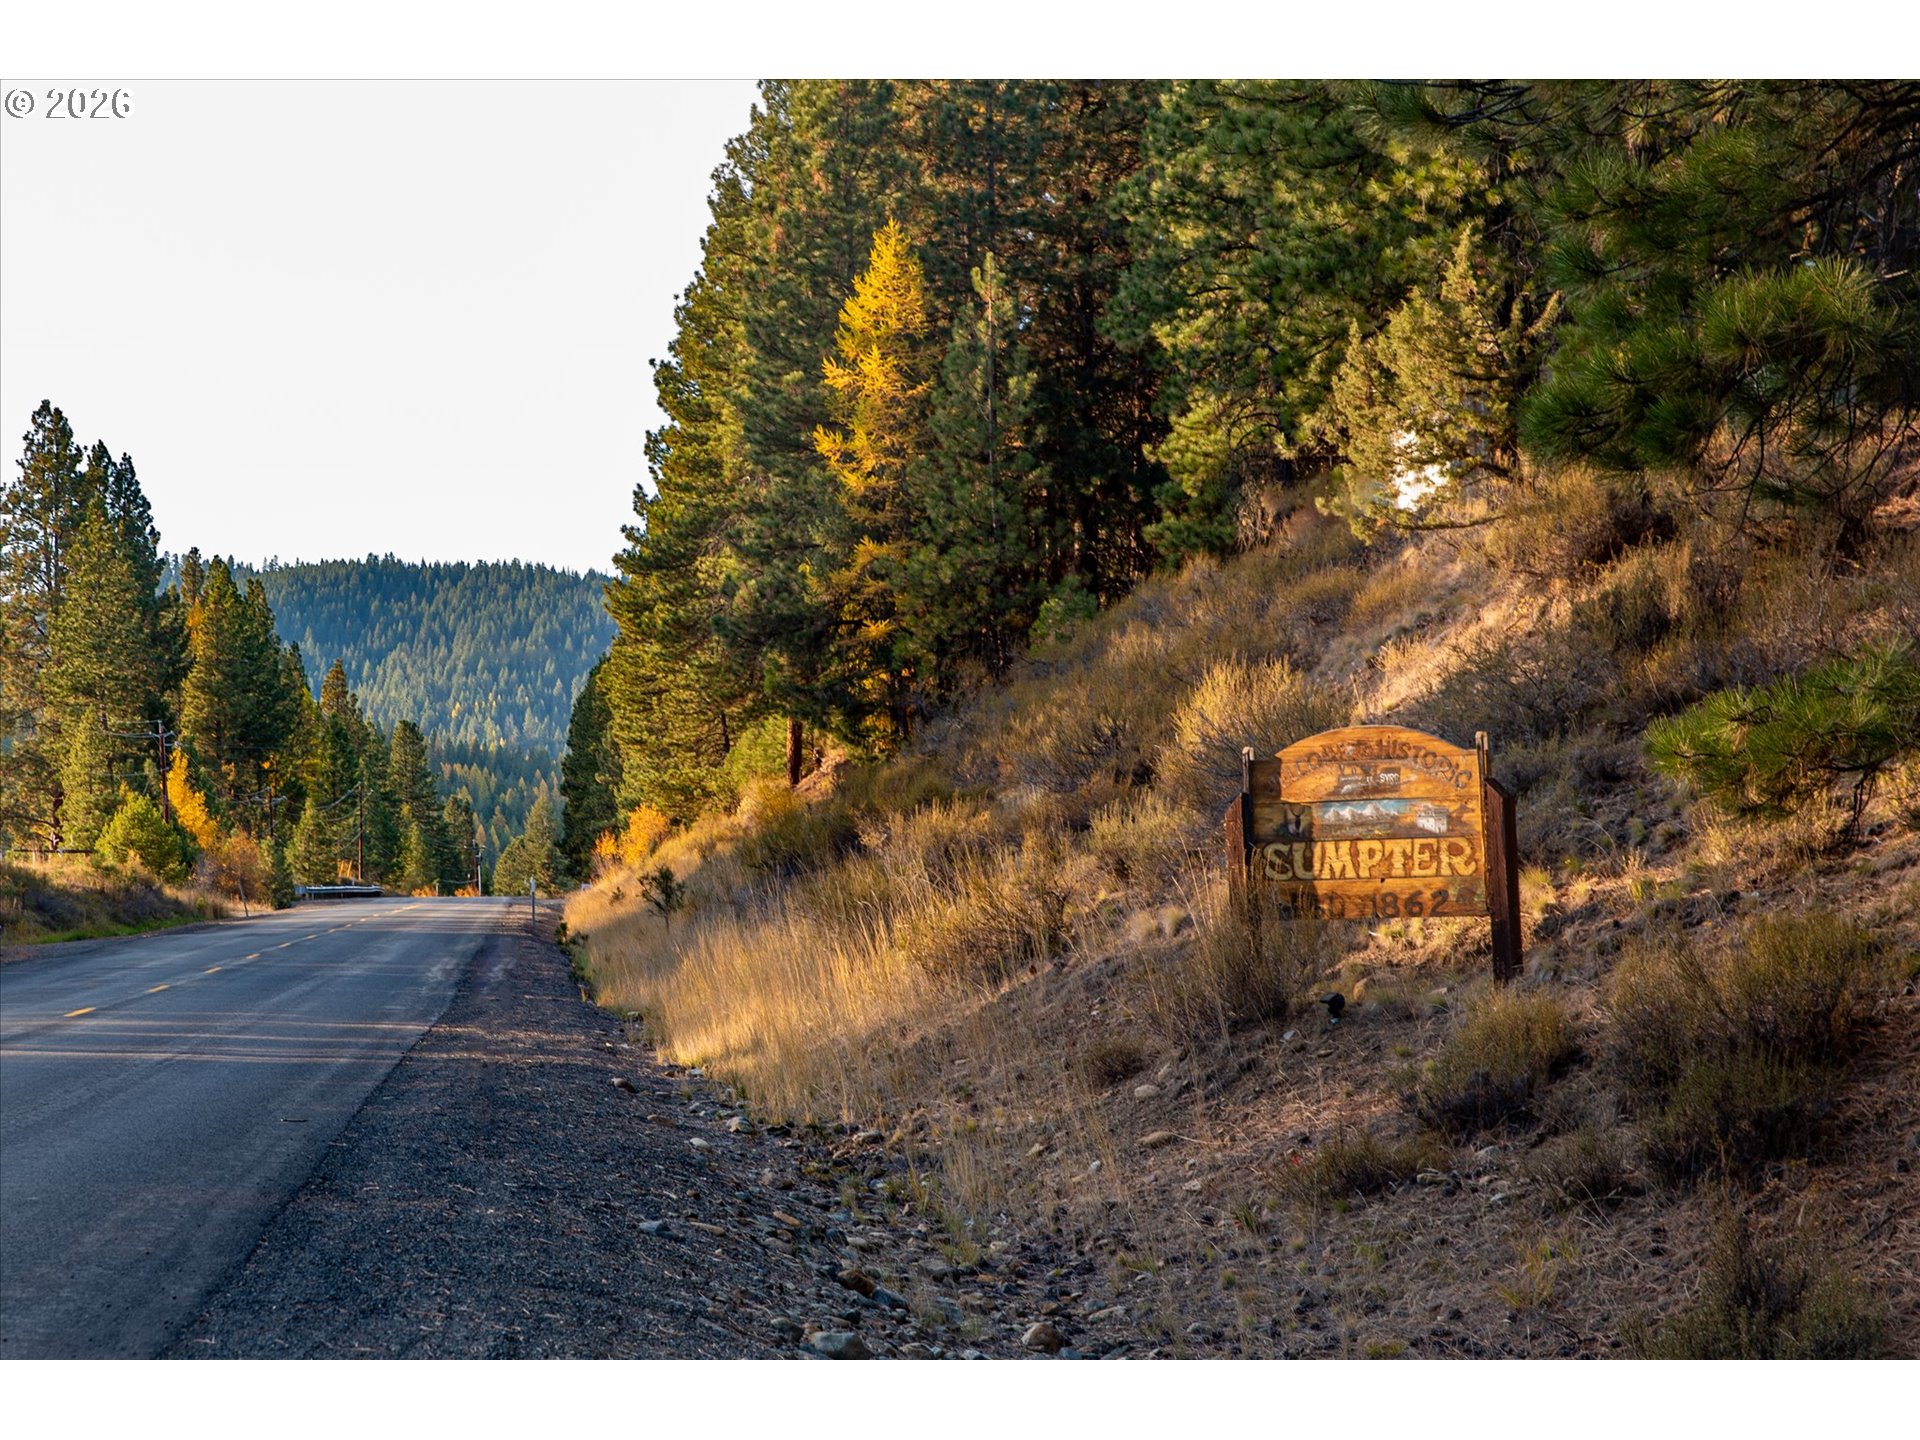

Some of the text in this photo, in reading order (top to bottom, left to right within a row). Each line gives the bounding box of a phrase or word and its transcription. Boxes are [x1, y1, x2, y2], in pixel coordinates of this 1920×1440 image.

[1376, 735, 1472, 790] HISTORIC
[1263, 836, 1478, 881] SUMPTER
[1372, 888, 1450, 919] 1862
